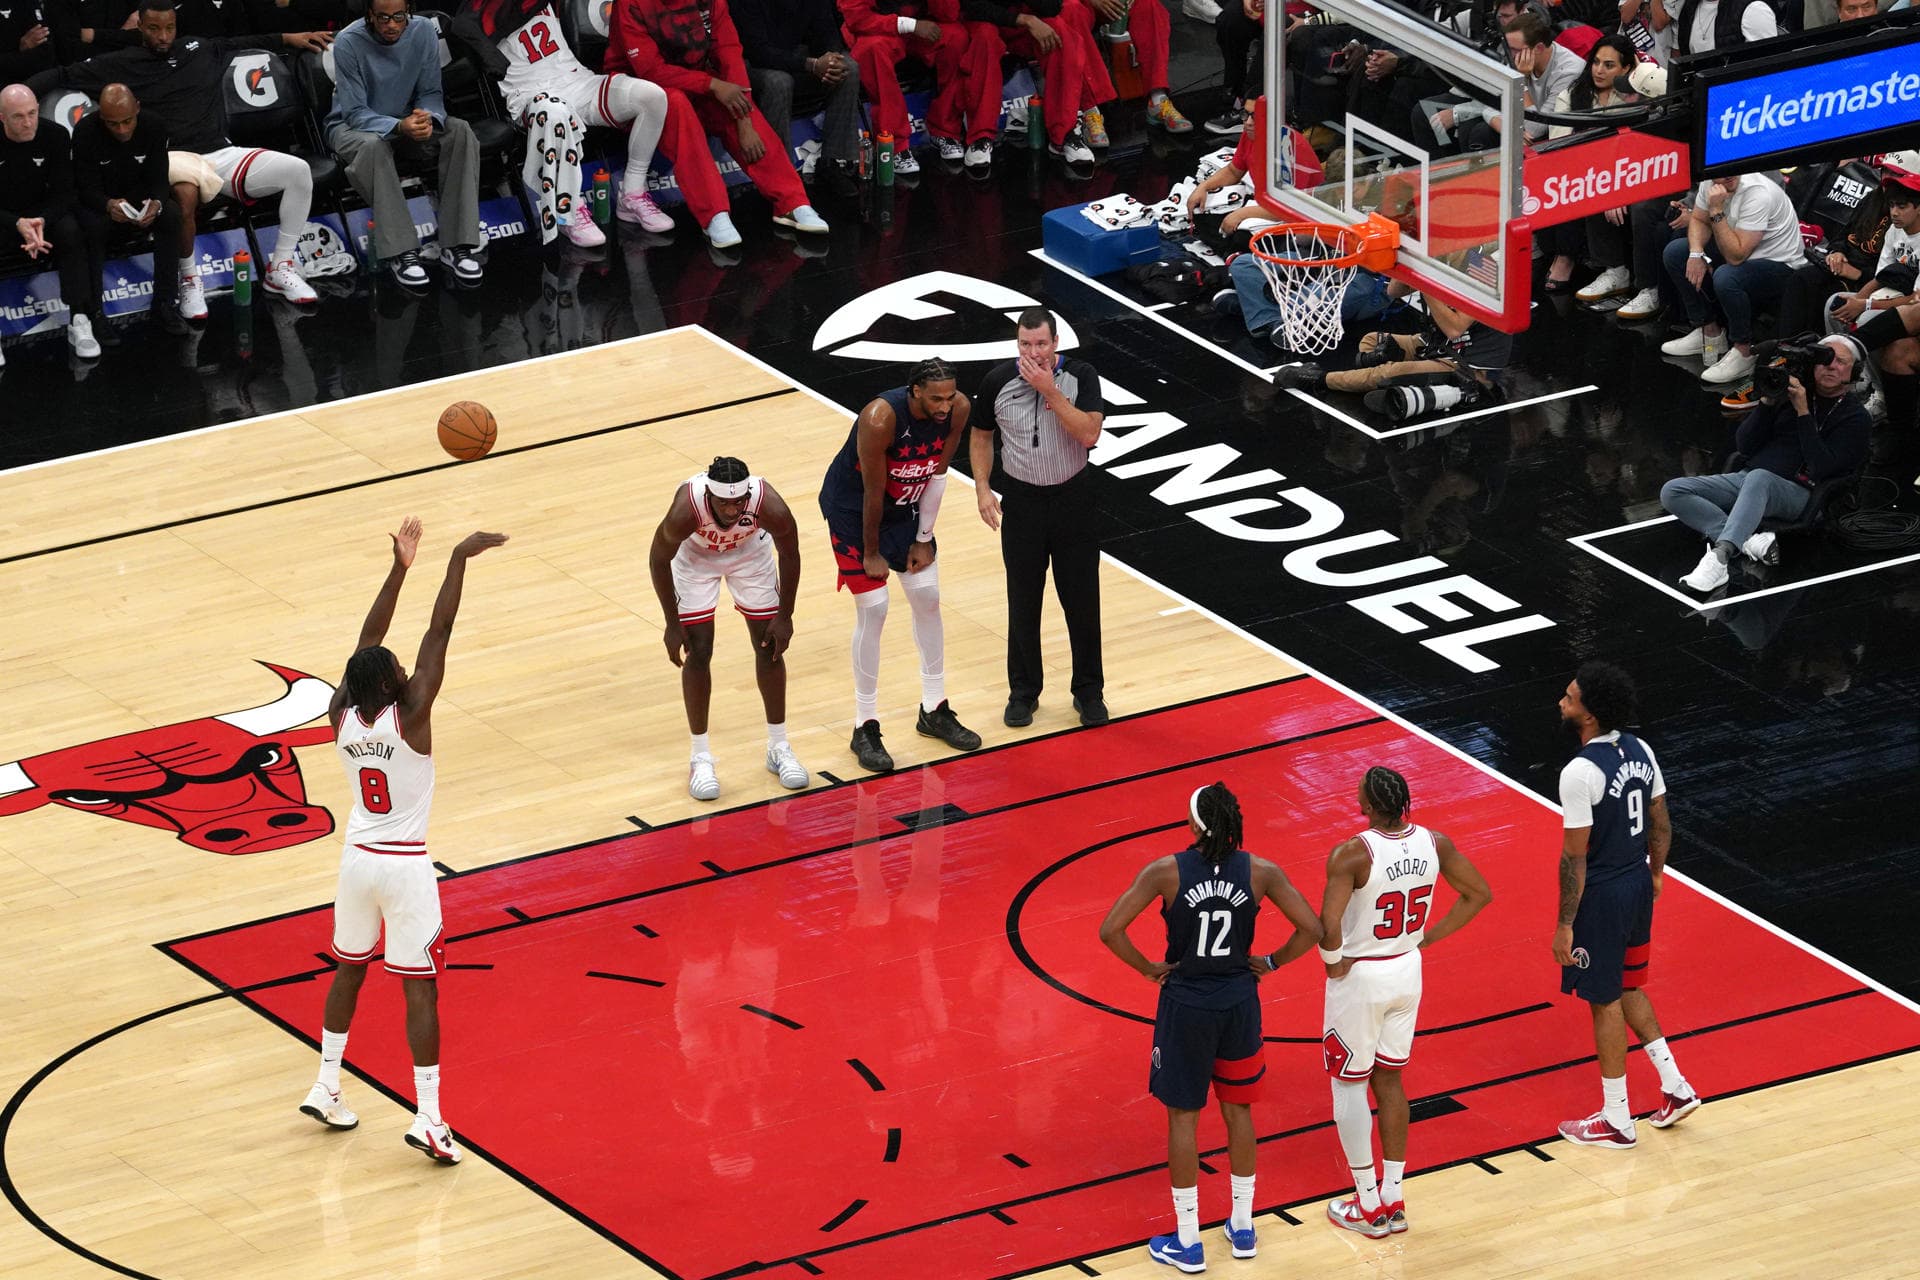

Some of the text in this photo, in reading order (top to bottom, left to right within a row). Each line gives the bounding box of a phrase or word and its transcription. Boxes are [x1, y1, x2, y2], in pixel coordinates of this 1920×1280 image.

[518, 21, 560, 64] 12
[1720, 71, 1920, 140] ticketmaste
[1543, 150, 1678, 210] State Farm
[1827, 189, 1859, 208] MUSEU
[890, 460, 940, 478] distric
[895, 483, 925, 505] 20
[343, 742, 395, 760] WILSON
[359, 767, 392, 814] 8
[1627, 789, 1643, 837] 9
[1386, 858, 1428, 882] OKORO
[1230, 889, 1248, 907] III
[1373, 884, 1433, 940] 35
[1197, 910, 1232, 956] 12
